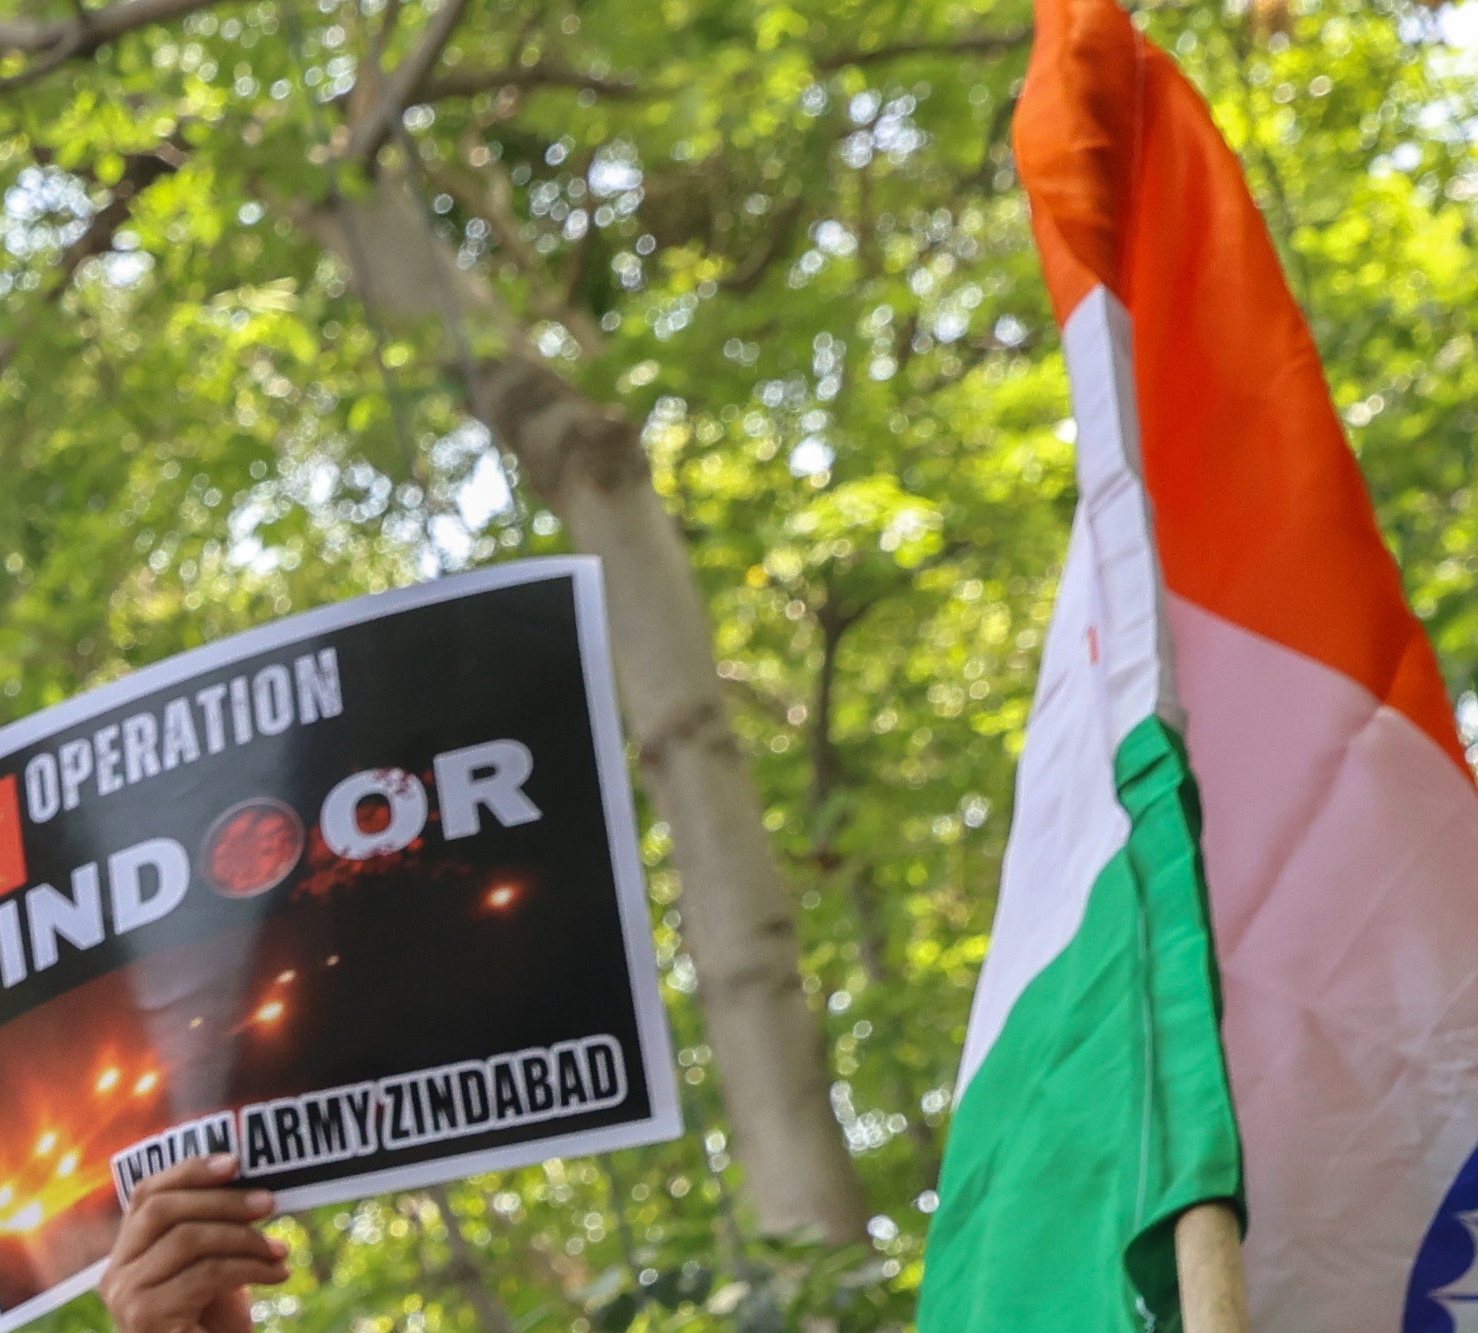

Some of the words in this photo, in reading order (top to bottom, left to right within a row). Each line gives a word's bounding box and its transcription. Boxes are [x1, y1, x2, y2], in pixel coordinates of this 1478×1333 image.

[25, 648, 343, 823] OPERATION
[248, 1089, 372, 1169] ARMY
[384, 1044, 618, 1141] ZINDABAD
